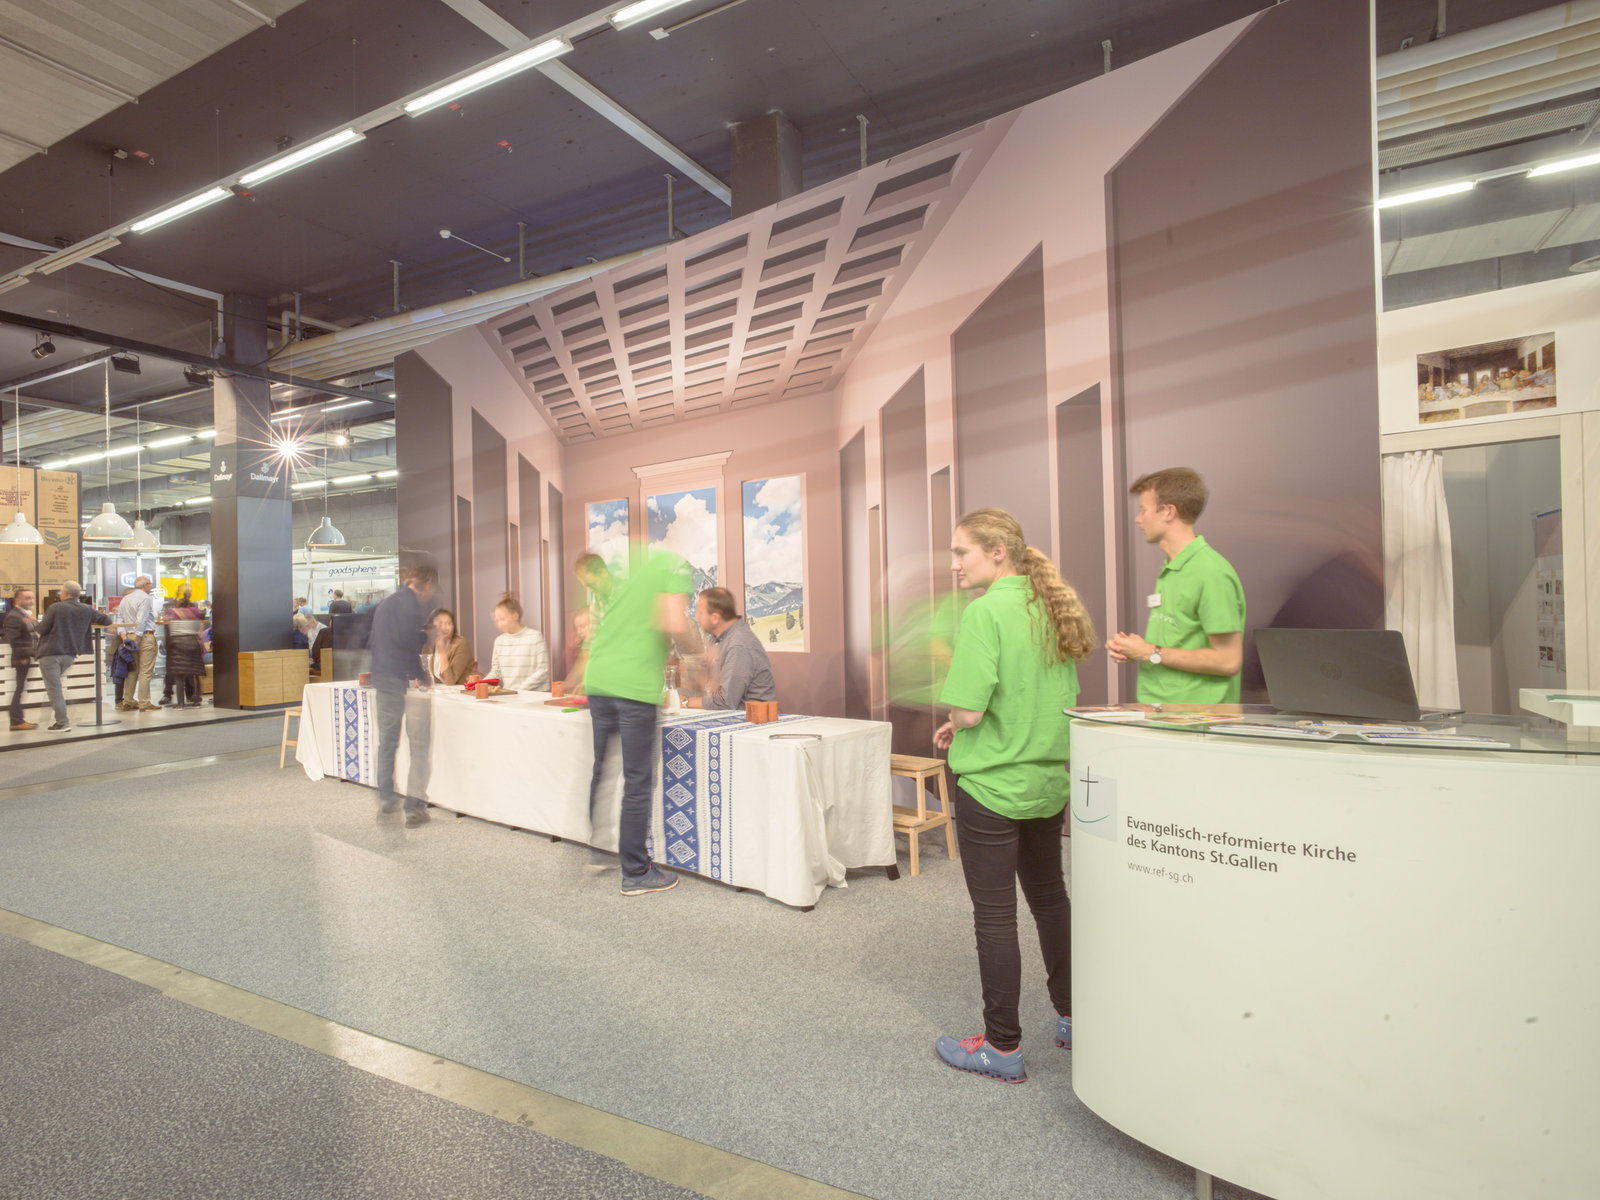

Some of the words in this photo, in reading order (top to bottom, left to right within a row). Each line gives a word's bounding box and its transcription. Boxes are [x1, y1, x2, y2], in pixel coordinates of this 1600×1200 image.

[250, 472, 280, 483] Dallmayr
[1126, 834, 1147, 849] des
[1151, 839, 1205, 861] Kantons
[1210, 849, 1278, 873] St.Gallen
[1127, 815, 1296, 855] Evangelisch-reformierte
[1303, 843, 1357, 863] Kirche
[1127, 861, 1194, 884] www.ref-sg.ch
